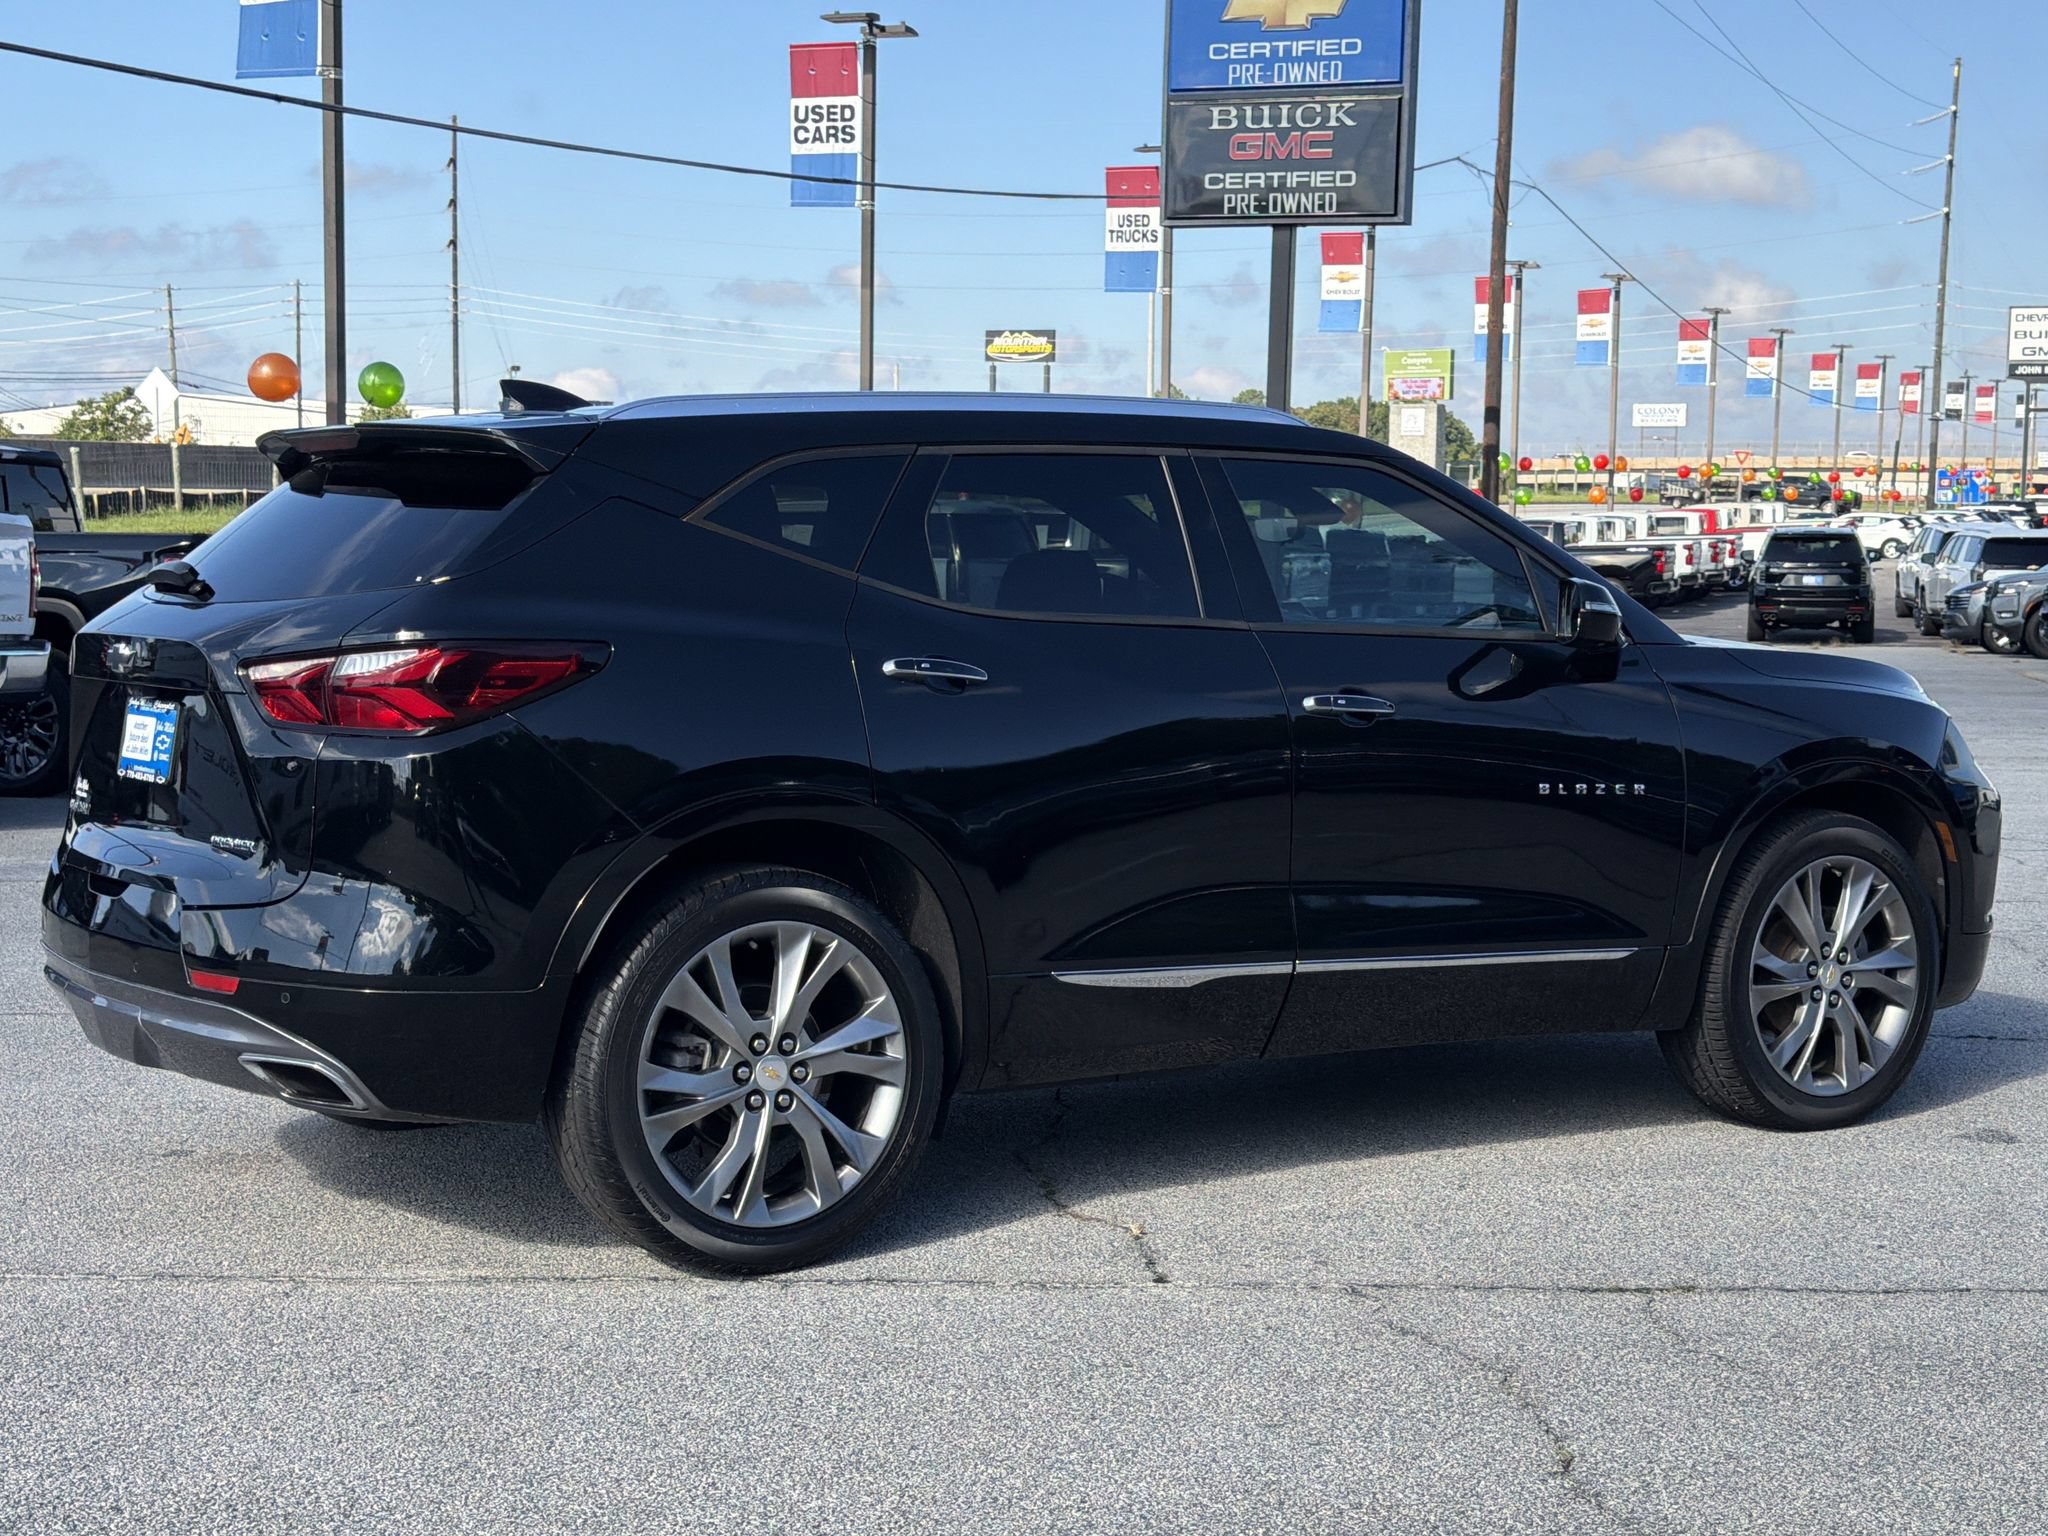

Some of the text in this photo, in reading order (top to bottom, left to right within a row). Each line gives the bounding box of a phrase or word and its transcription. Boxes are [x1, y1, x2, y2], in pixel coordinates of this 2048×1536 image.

[1208, 38, 1362, 60] CERTIFIED
[1228, 60, 1342, 85] PRE-OWNED
[793, 104, 856, 124] USED
[1208, 102, 1358, 130] BUICK
[793, 124, 856, 145] CARS
[1228, 131, 1334, 160] GMC
[1203, 170, 1357, 189] CERTIFIED
[1223, 192, 1337, 215] PRE-OWNED
[1117, 214, 1151, 228] USED
[1108, 229, 1159, 243] TRUCKS
[2014, 365, 2042, 374] JOHN
[1637, 407, 1681, 415] COLONY
[1538, 783, 1646, 795] BLAZER
